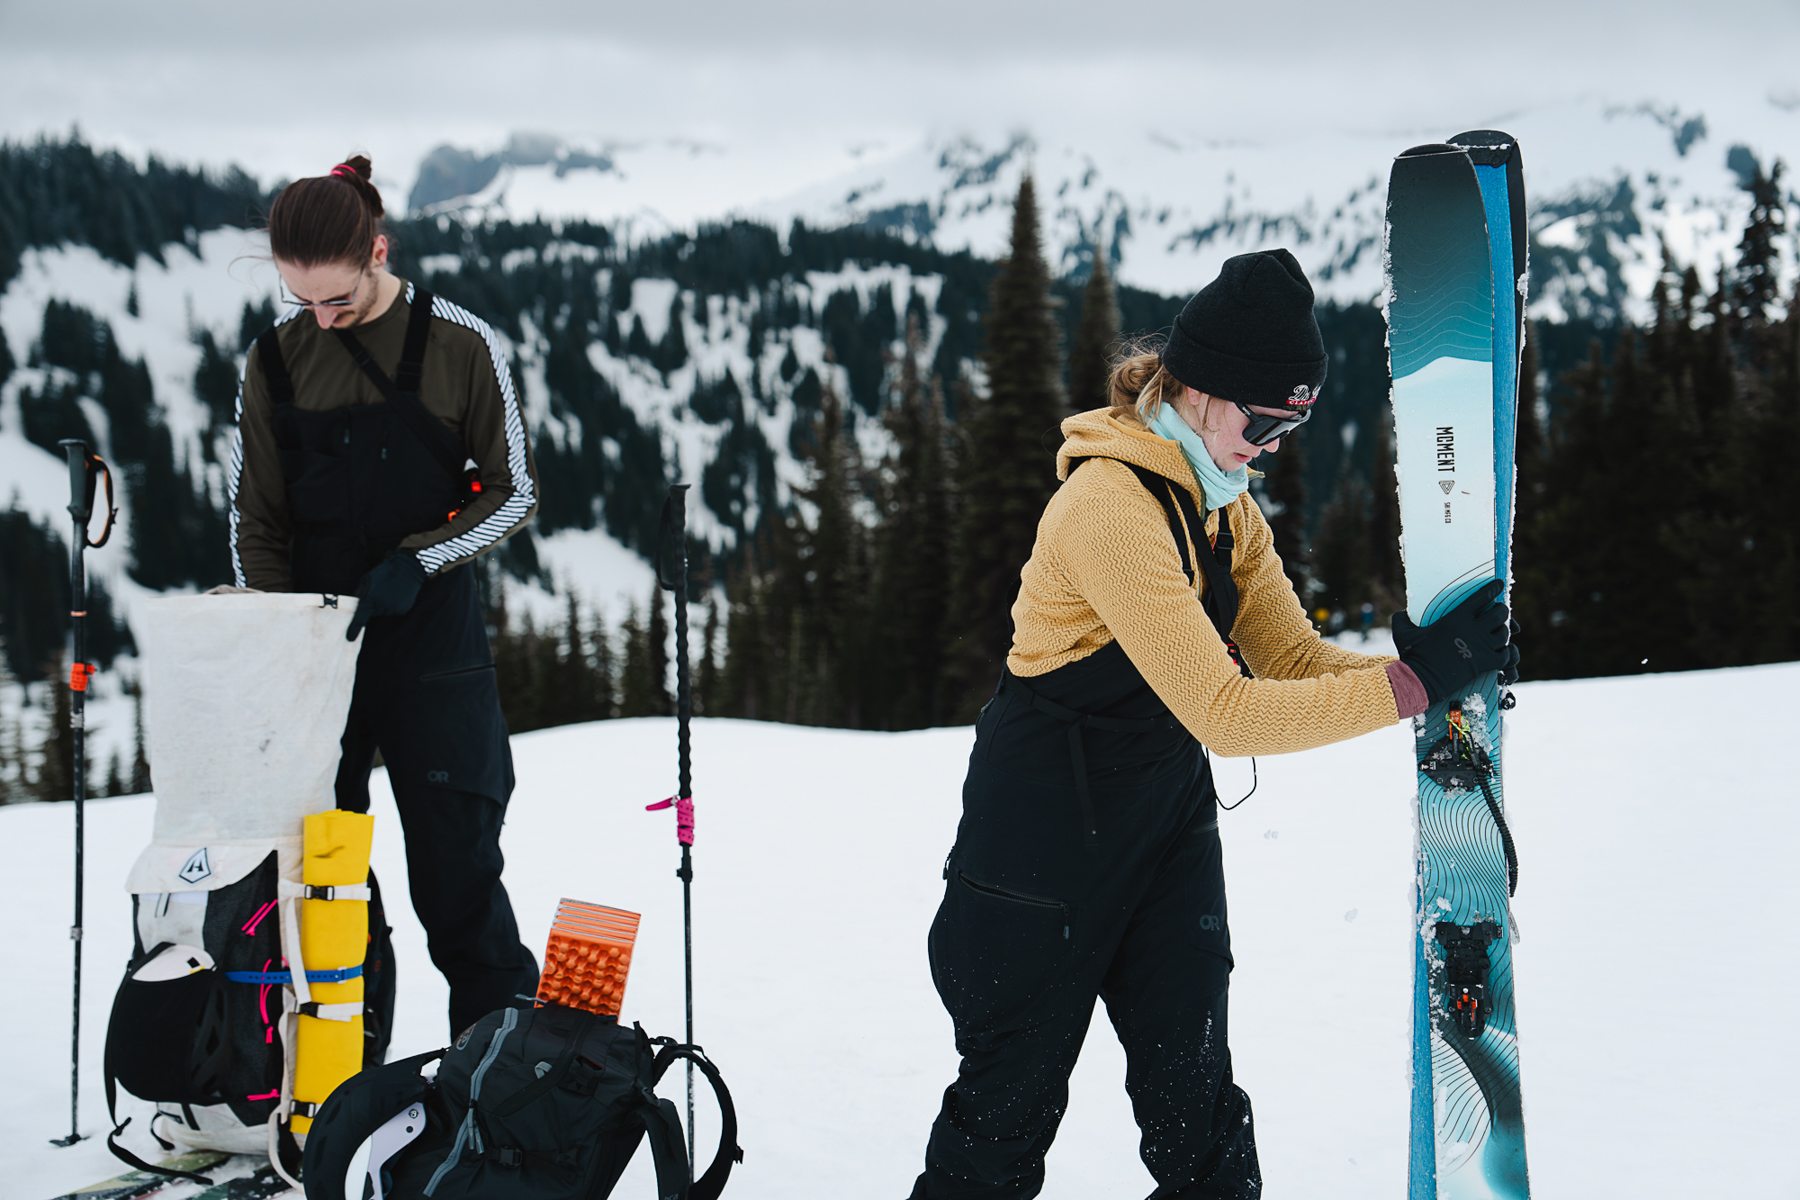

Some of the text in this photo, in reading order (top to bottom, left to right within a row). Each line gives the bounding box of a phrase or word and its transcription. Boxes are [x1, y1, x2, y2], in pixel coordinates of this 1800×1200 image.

[1453, 638, 1473, 659] OR
[427, 770, 449, 783] OR
[1199, 914, 1220, 931] OR
